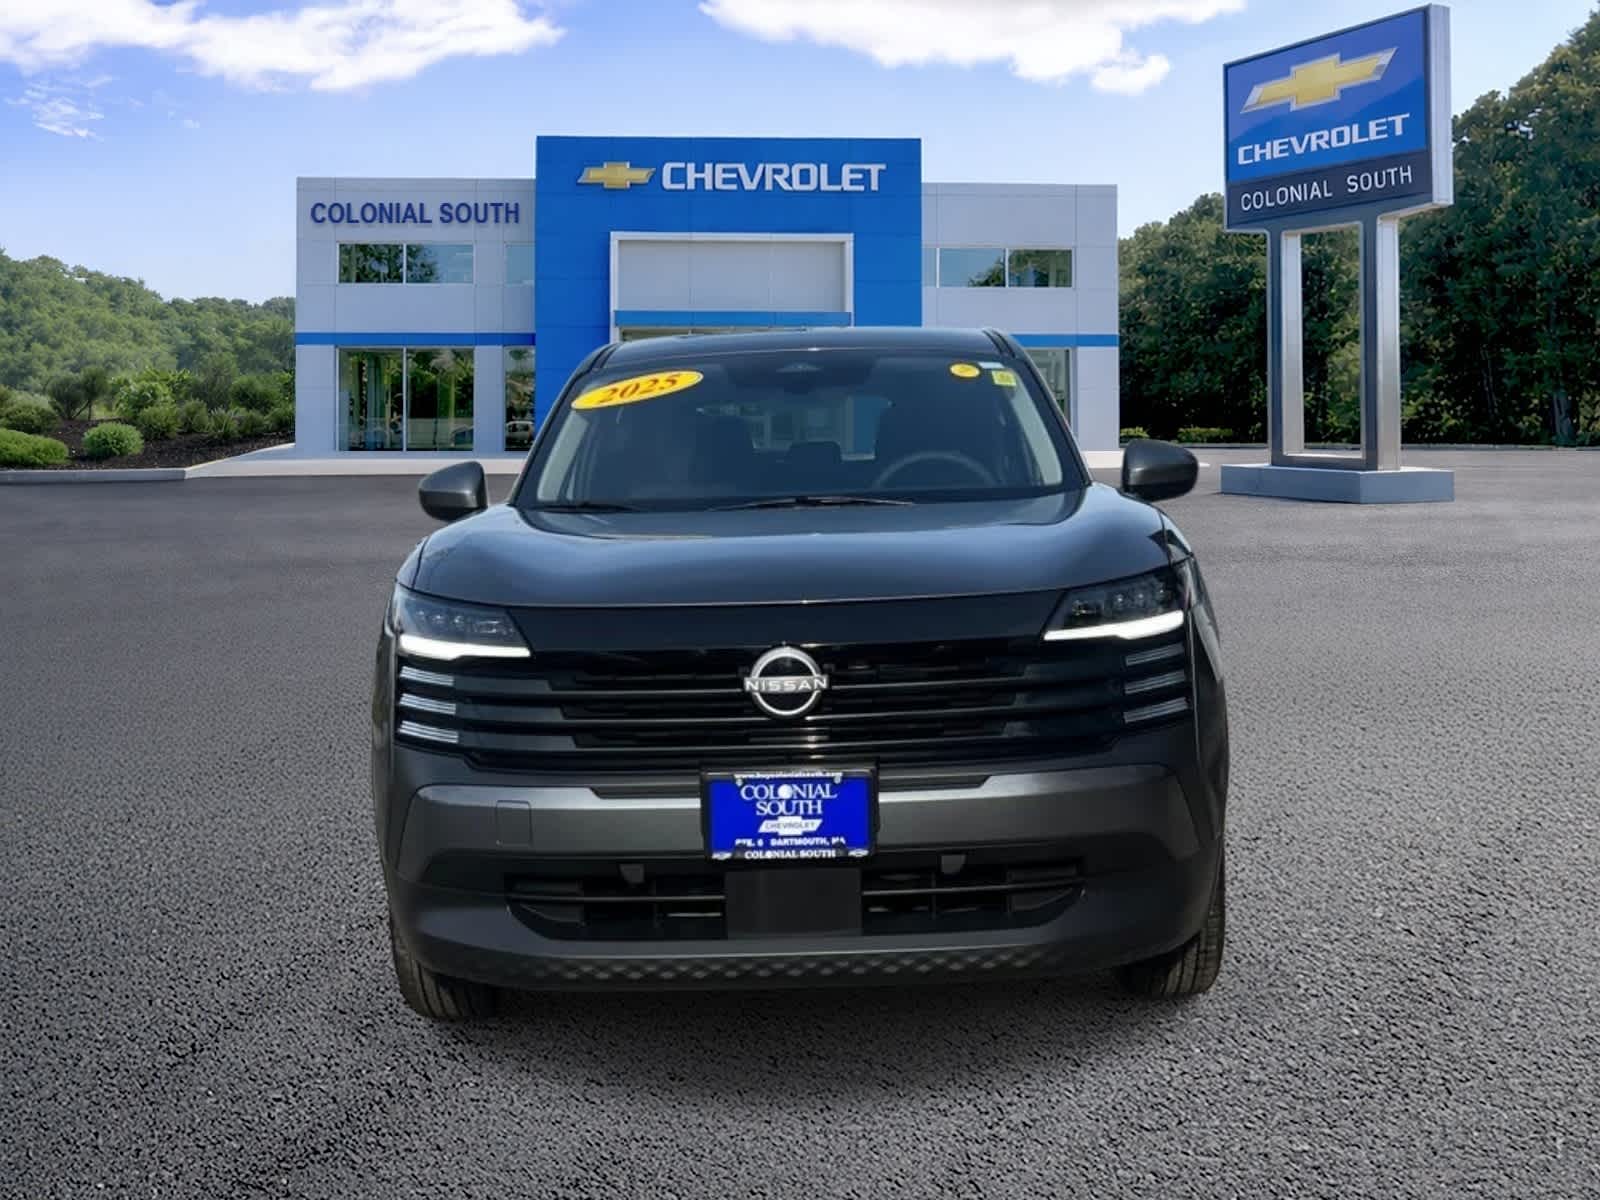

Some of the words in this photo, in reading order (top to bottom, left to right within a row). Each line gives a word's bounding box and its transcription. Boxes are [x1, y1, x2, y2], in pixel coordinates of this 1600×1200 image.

[1238, 113, 1409, 165] CHEVROLET
[662, 161, 887, 192] CHEVROLET
[1241, 180, 1333, 211] COLONIAL
[1346, 165, 1412, 193] SOUTH
[310, 202, 432, 225] COLONIAL
[439, 202, 520, 224] SOUTH
[599, 373, 681, 403] 2025
[744, 677, 828, 692] NISSAN
[740, 784, 838, 800] COLONIAL
[756, 800, 823, 815] SOUTH
[765, 821, 816, 830] CHEVROLET
[744, 850, 798, 859] COLONIAL
[799, 849, 836, 858] SOUTH
